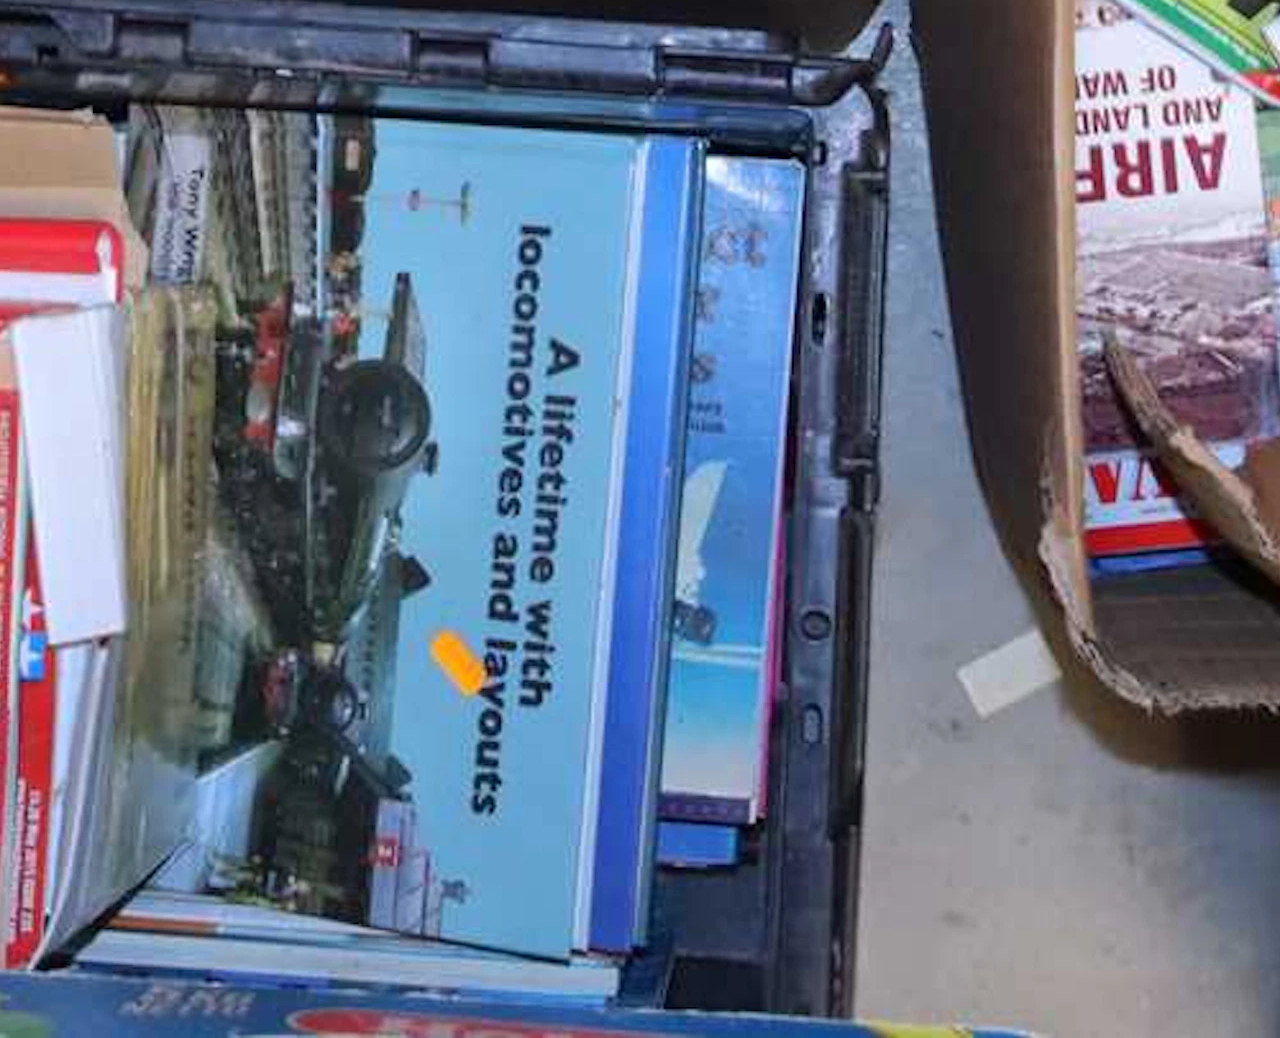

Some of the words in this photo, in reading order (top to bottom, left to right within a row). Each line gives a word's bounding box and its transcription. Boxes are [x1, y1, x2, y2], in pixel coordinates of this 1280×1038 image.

[1140, 66, 1177, 94] OF
[1162, 95, 1224, 129] AND
[497, 223, 552, 517] locomotives
[547, 337, 581, 376] A
[528, 393, 578, 584] lifetime
[485, 540, 519, 624] and
[518, 599, 555, 708] with
[469, 634, 519, 816] layouts
